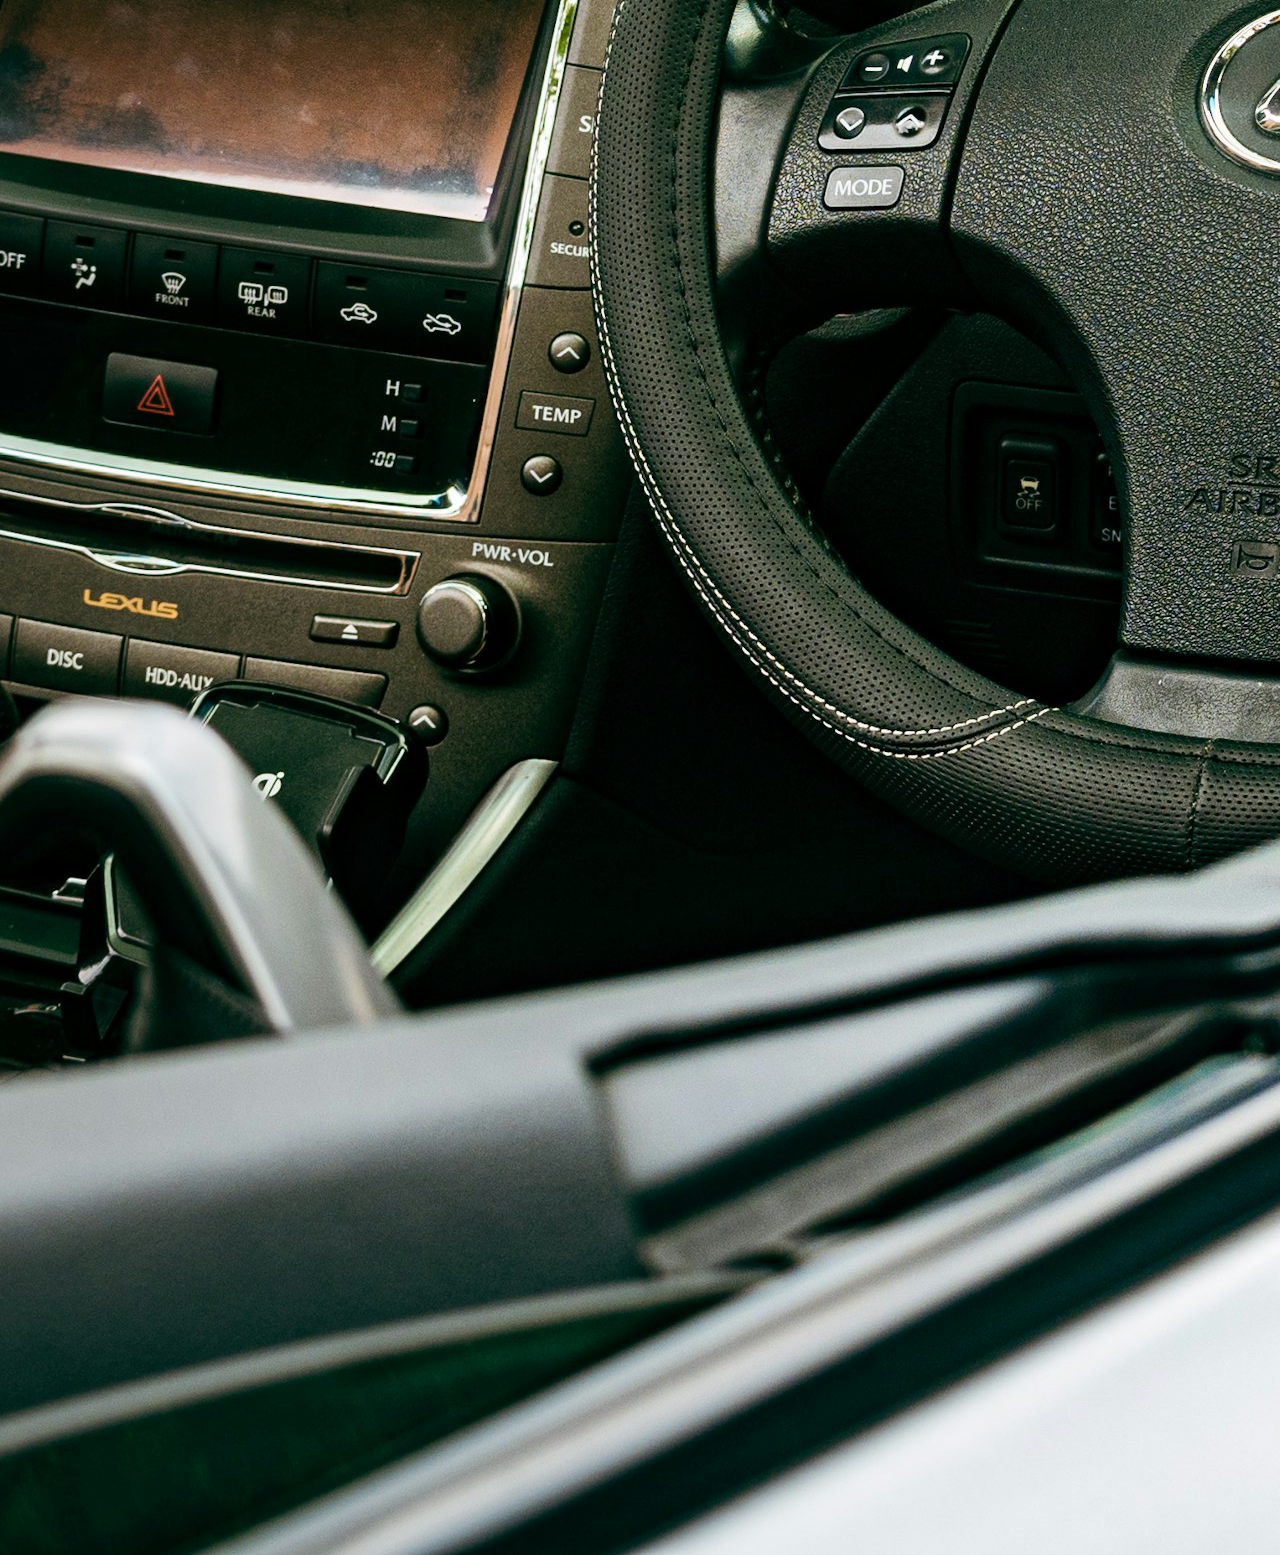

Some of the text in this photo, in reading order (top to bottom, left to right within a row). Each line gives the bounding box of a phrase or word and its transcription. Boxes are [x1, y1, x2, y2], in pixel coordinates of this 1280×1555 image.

[834, 177, 893, 199] MODE
[155, 292, 190, 309] FRONT
[247, 306, 277, 320] REAR
[385, 379, 401, 397] H
[531, 404, 583, 425] TEMP
[381, 415, 398, 433] M
[1015, 497, 1044, 512] OFF
[83, 587, 179, 620] LEXUS
[45, 647, 84, 671] DISC
